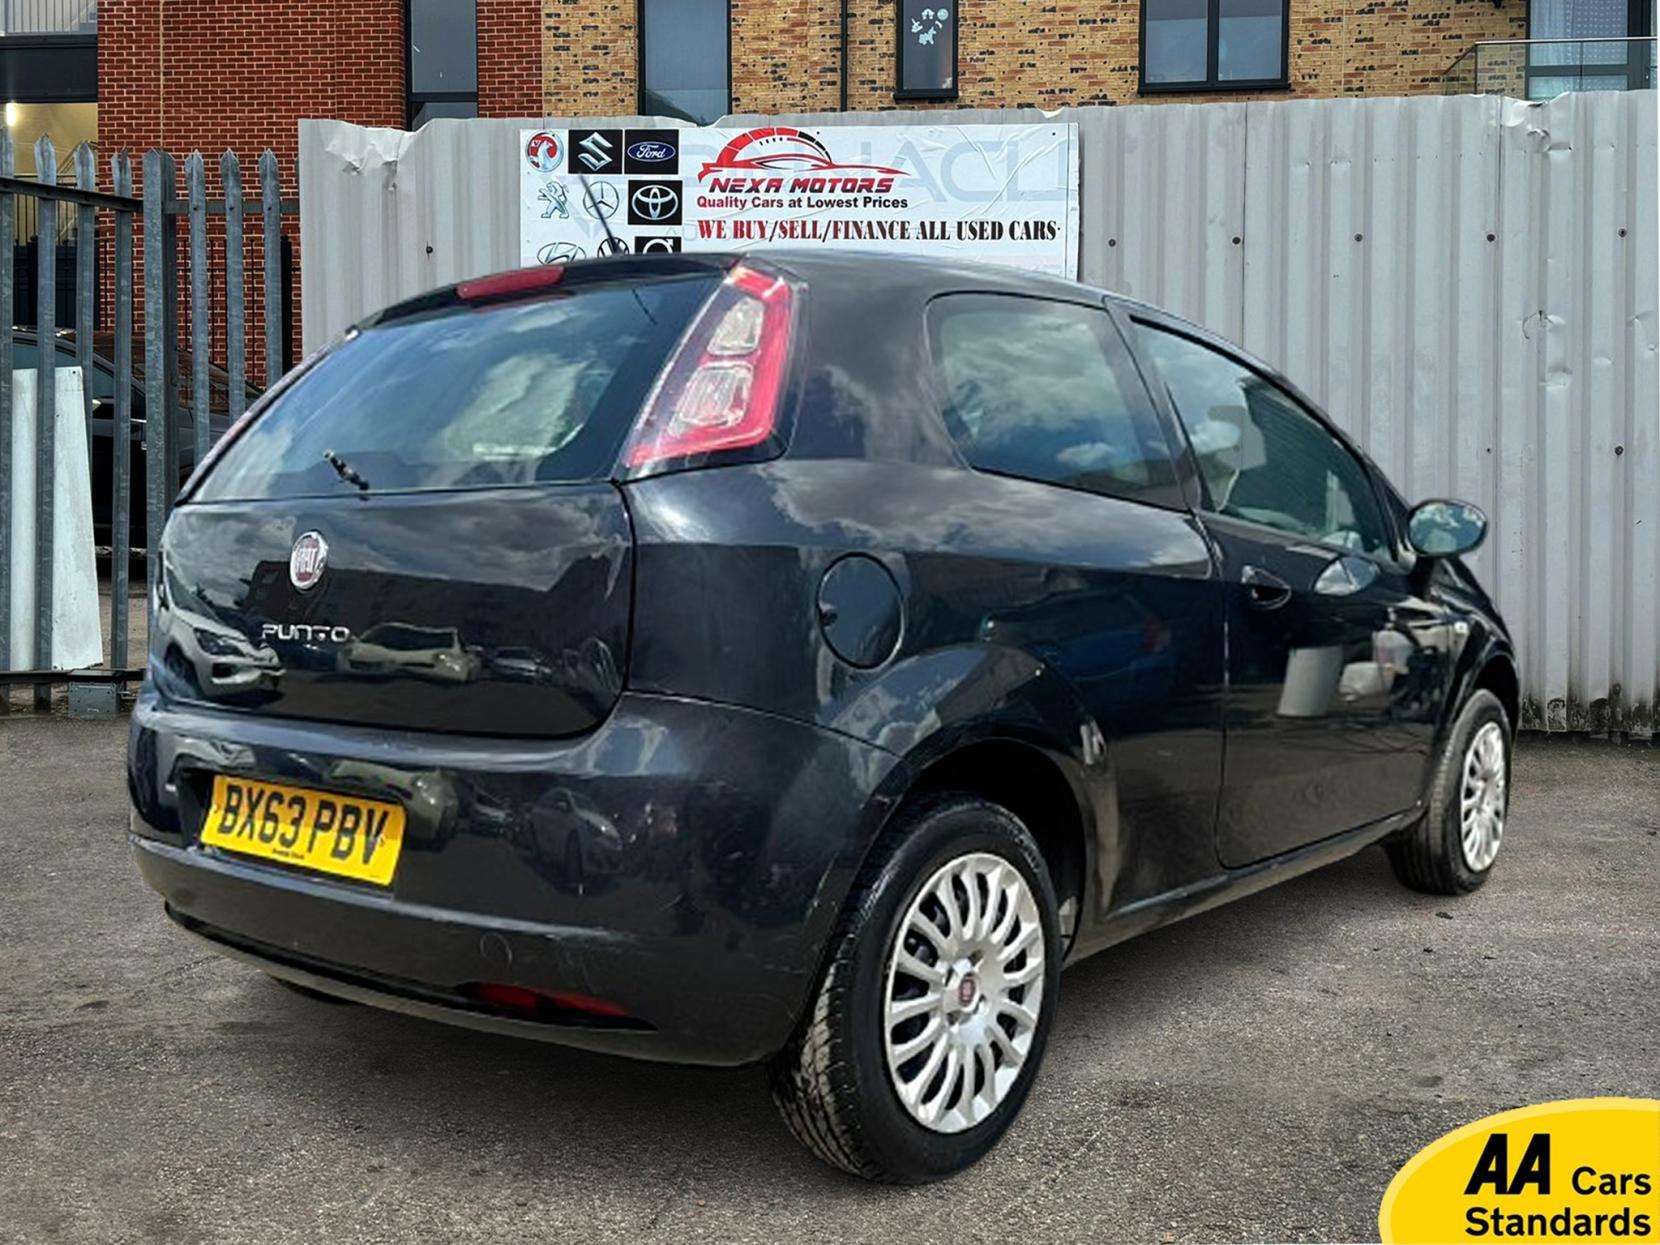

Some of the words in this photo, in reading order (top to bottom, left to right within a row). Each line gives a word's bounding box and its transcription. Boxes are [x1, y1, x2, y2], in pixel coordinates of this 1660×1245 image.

[636, 144, 665, 159] Ford
[709, 177, 784, 194] NEXA
[789, 177, 894, 194] MOTORS
[697, 195, 748, 211] Quality
[752, 195, 784, 208] Cars
[788, 196, 803, 208] at
[807, 196, 858, 208] Lowest
[863, 196, 908, 209] Prices
[697, 219, 727, 240] WE
[732, 219, 910, 243] BUY/SELL/FINANCE
[915, 220, 951, 241] ALL
[956, 220, 1004, 241] USED
[1008, 220, 1057, 241] CARS
[262, 623, 351, 642] PUNTO
[218, 784, 307, 849] BX63
[307, 799, 390, 865] PBV
